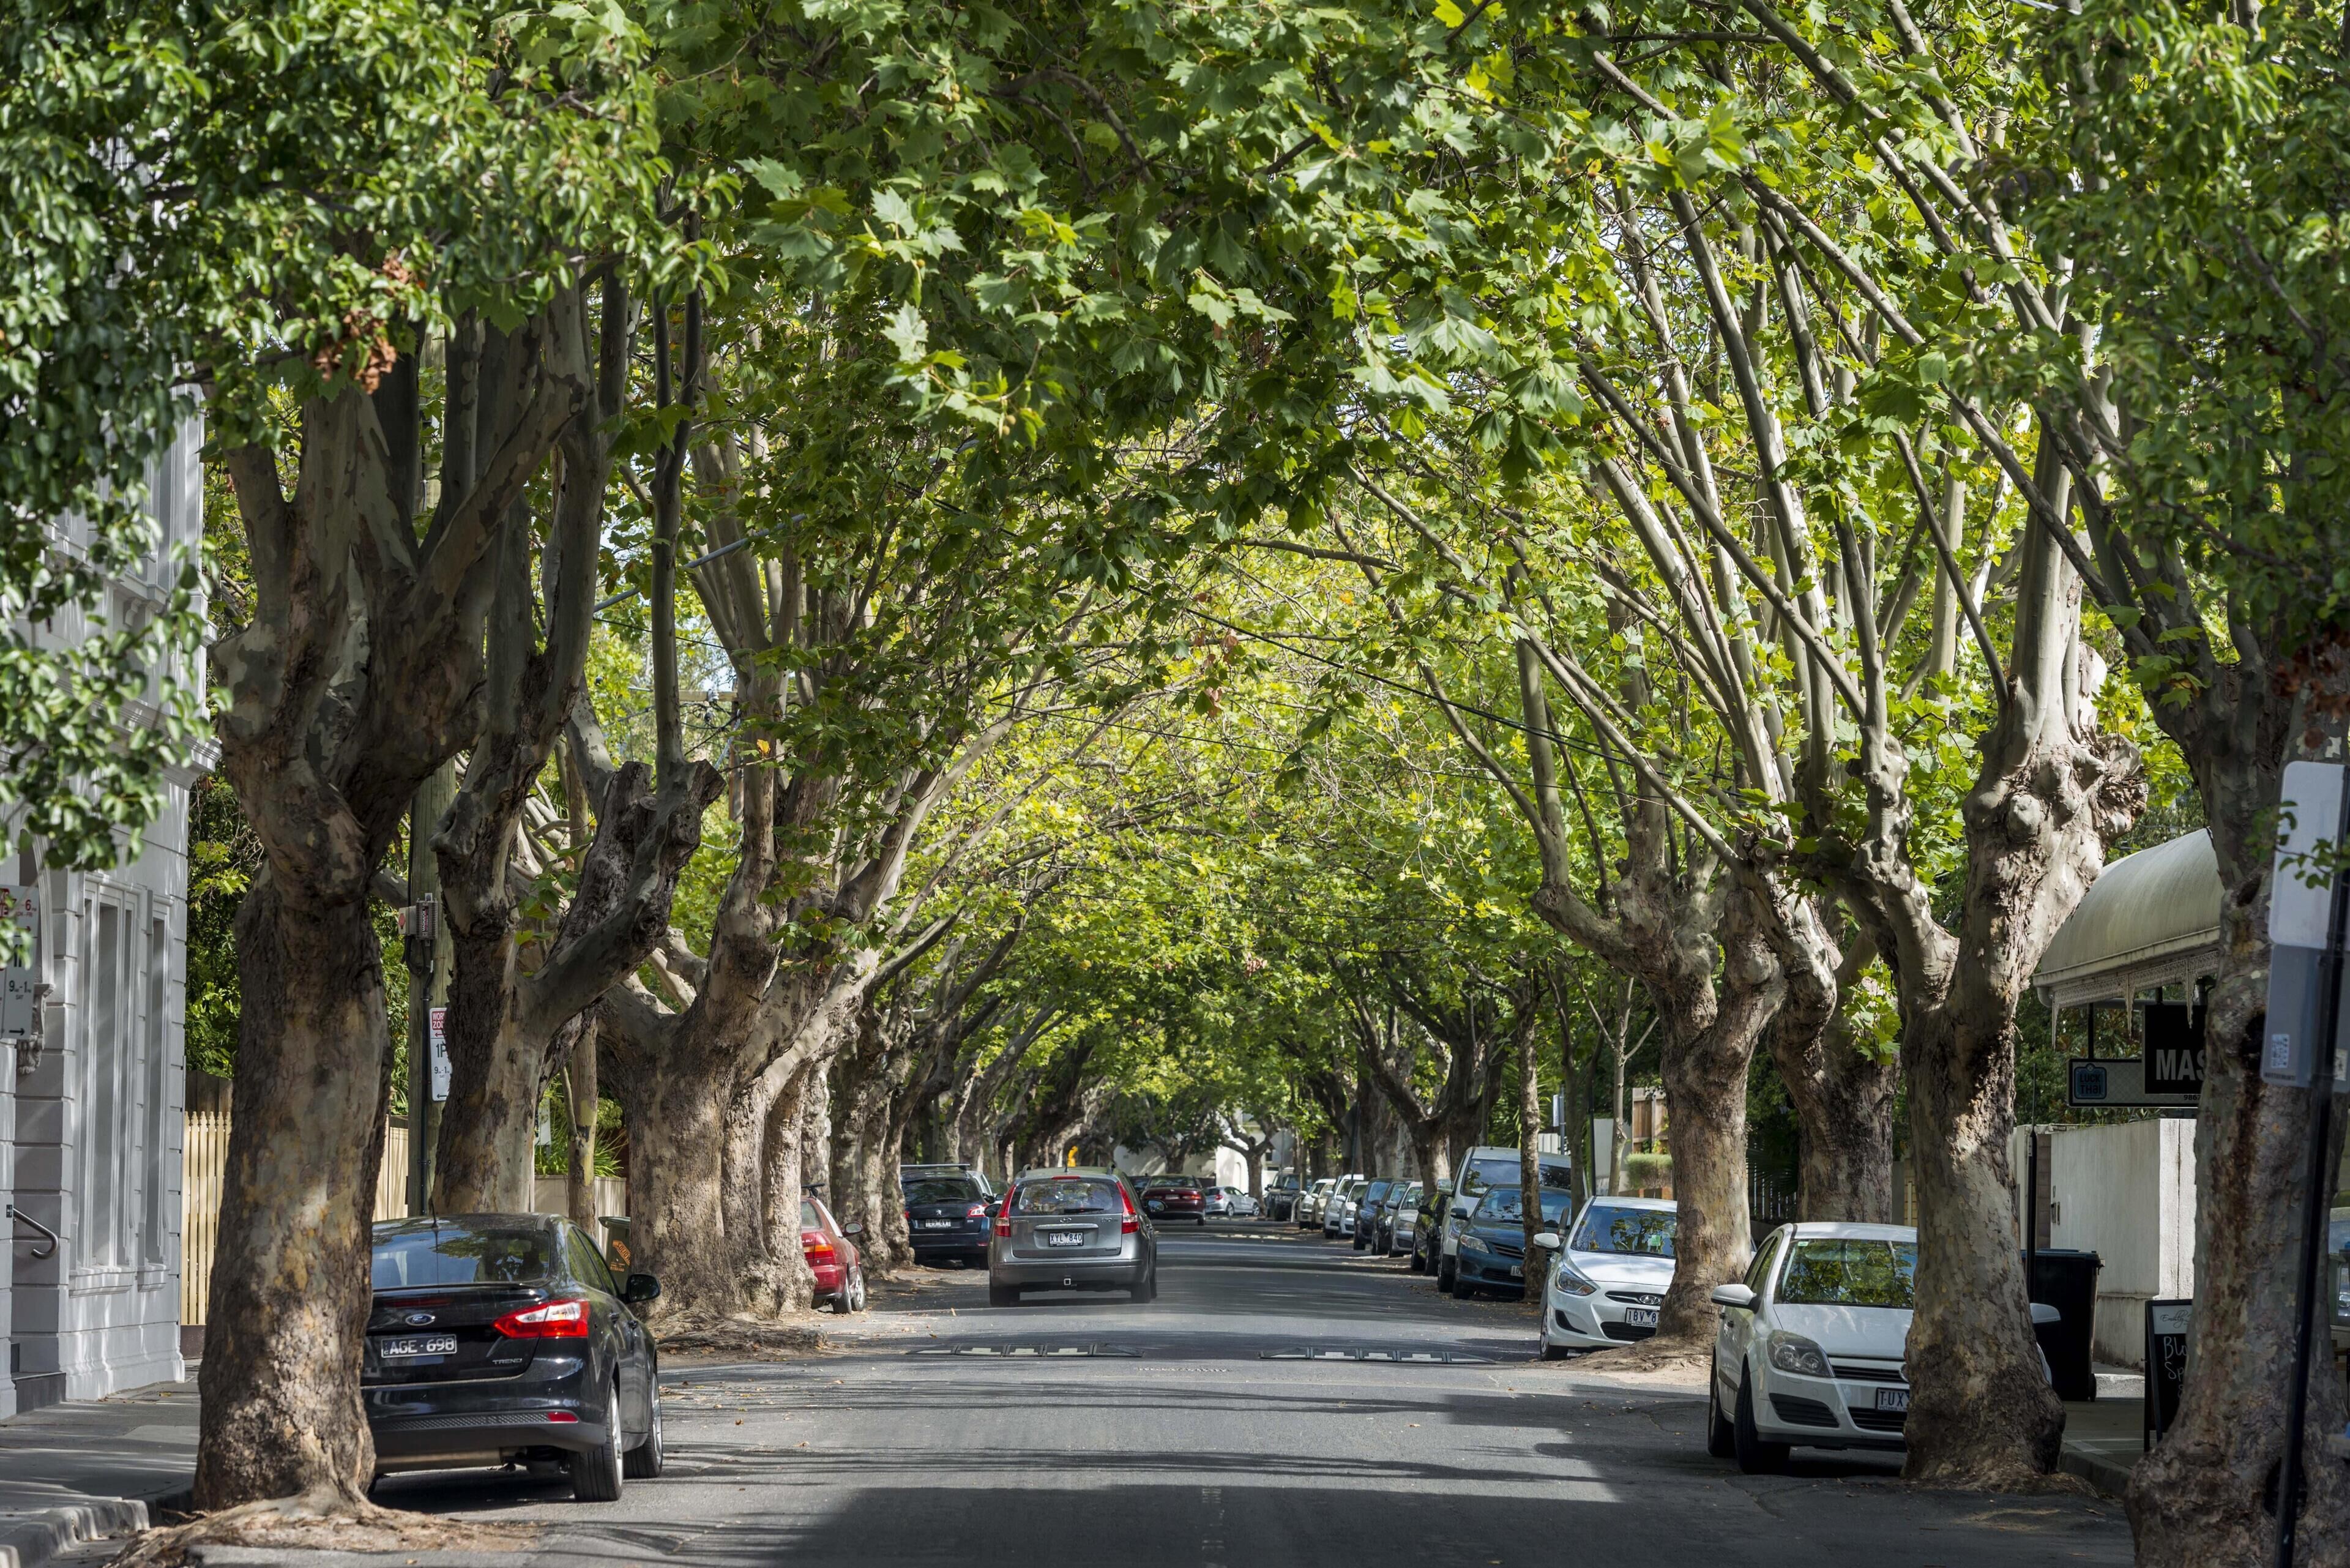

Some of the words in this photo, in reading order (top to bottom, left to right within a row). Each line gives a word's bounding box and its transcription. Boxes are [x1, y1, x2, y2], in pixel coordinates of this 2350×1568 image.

[1628, 1311, 1644, 1322] 1BV
[390, 1340, 417, 1354] AGE
[427, 1338, 455, 1352] 698
[2165, 1361, 2184, 1381] Sp
